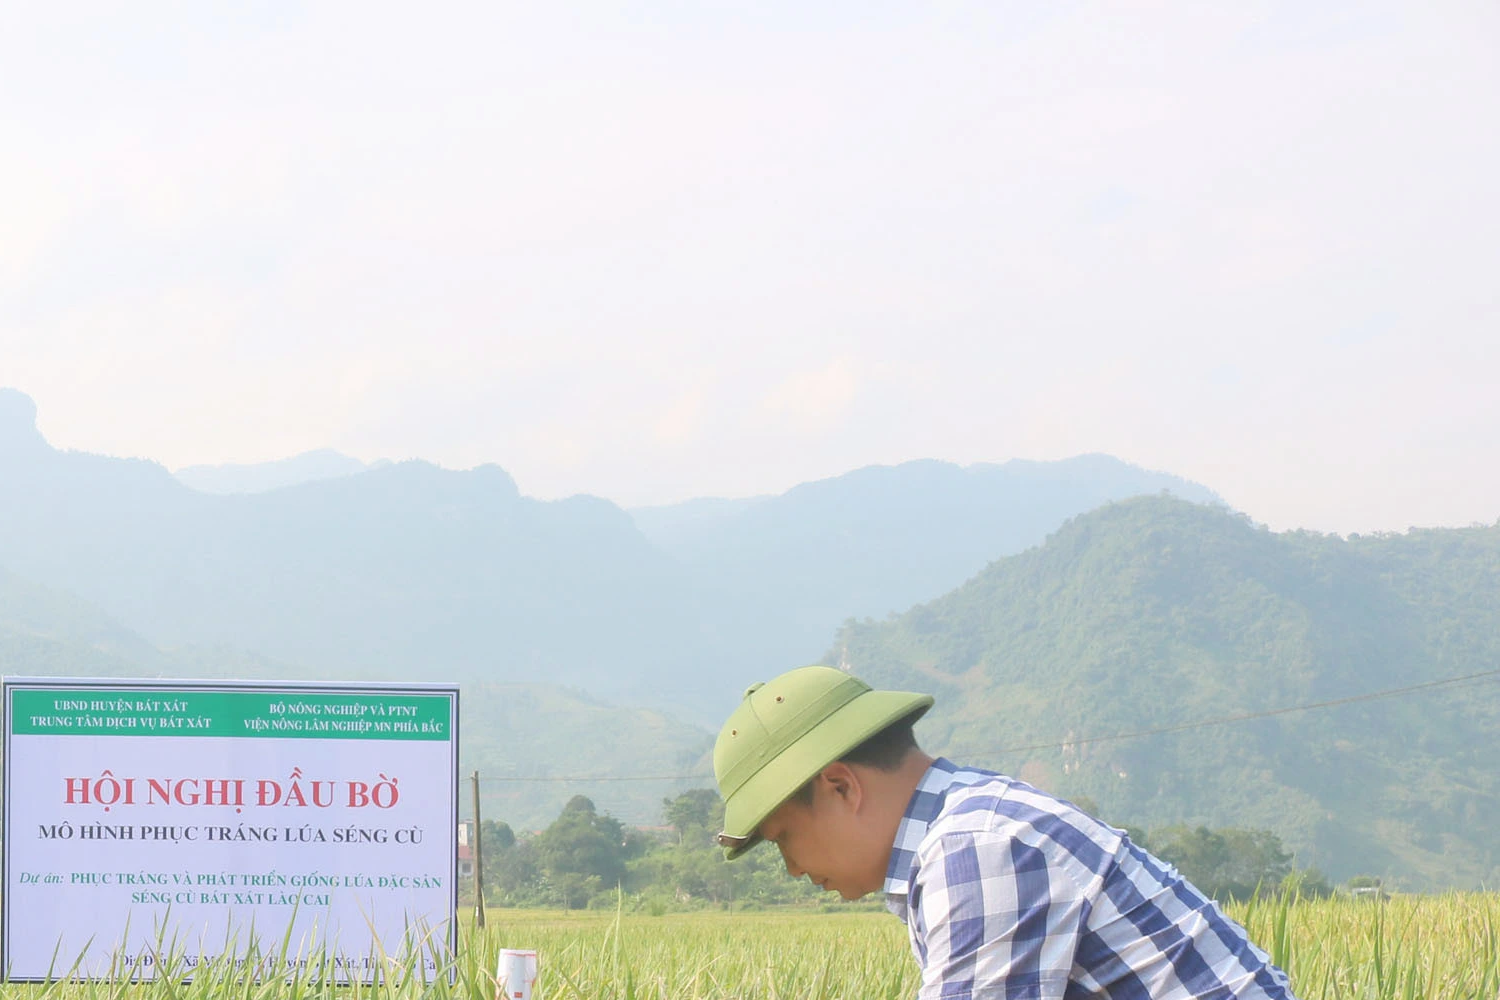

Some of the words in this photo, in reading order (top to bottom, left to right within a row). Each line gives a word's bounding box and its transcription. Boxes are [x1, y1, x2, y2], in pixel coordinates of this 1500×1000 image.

[54, 699, 88, 711] UBND
[91, 698, 133, 714] HUYỆN
[136, 698, 160, 712] BÁT
[163, 699, 189, 713] XÁT
[269, 701, 286, 716] BỘ
[288, 701, 321, 715] NÔNG
[324, 702, 367, 718] NGHIỆP
[370, 703, 386, 717] VÀ
[388, 705, 418, 717] PTNT
[30, 715, 72, 727] TRUNG
[76, 714, 104, 728] TÂM
[106, 716, 137, 730] DỊCH
[140, 717, 157, 730] VỤ
[159, 715, 184, 728] BÁT
[186, 716, 212, 729] XÁT
[243, 717, 270, 732] VIỆN
[272, 717, 302, 731] NÔNG
[305, 718, 329, 732] LÂM
[331, 719, 372, 734] NGHIỆP
[374, 721, 392, 733] MN
[393, 720, 419, 733] PHÍA
[421, 718, 444, 733] BẮC
[63, 769, 136, 812] HỘI
[147, 778, 246, 814] NGHỊ
[255, 767, 336, 808] ĐẦU
[346, 773, 399, 809] BỜ
[38, 821, 74, 840] MÔ
[80, 821, 134, 840] HÌNH
[139, 825, 199, 844] PHỤC
[204, 822, 278, 842] TRÁNG
[284, 824, 327, 842] LÚA
[332, 824, 389, 844] SÉNG
[394, 825, 424, 844] CÙ
[19, 871, 40, 886] Dự
[43, 871, 65, 884] án:
[70, 872, 113, 887] PHỤC
[115, 870, 168, 885] TRÁNG
[172, 870, 195, 885] VÀ
[197, 870, 238, 886] PHÁT
[240, 869, 287, 886] TRIỂN
[290, 870, 340, 887] GIỐNG
[344, 873, 374, 888] LÚA
[378, 873, 411, 890] ĐẶC
[412, 873, 443, 889] SẢN
[131, 889, 171, 904] SÉNG
[175, 889, 197, 904] CÙ
[200, 889, 229, 905] BÁT
[234, 890, 264, 905] XÁT
[268, 890, 299, 905] LÀO
[303, 893, 331, 906] CAI
